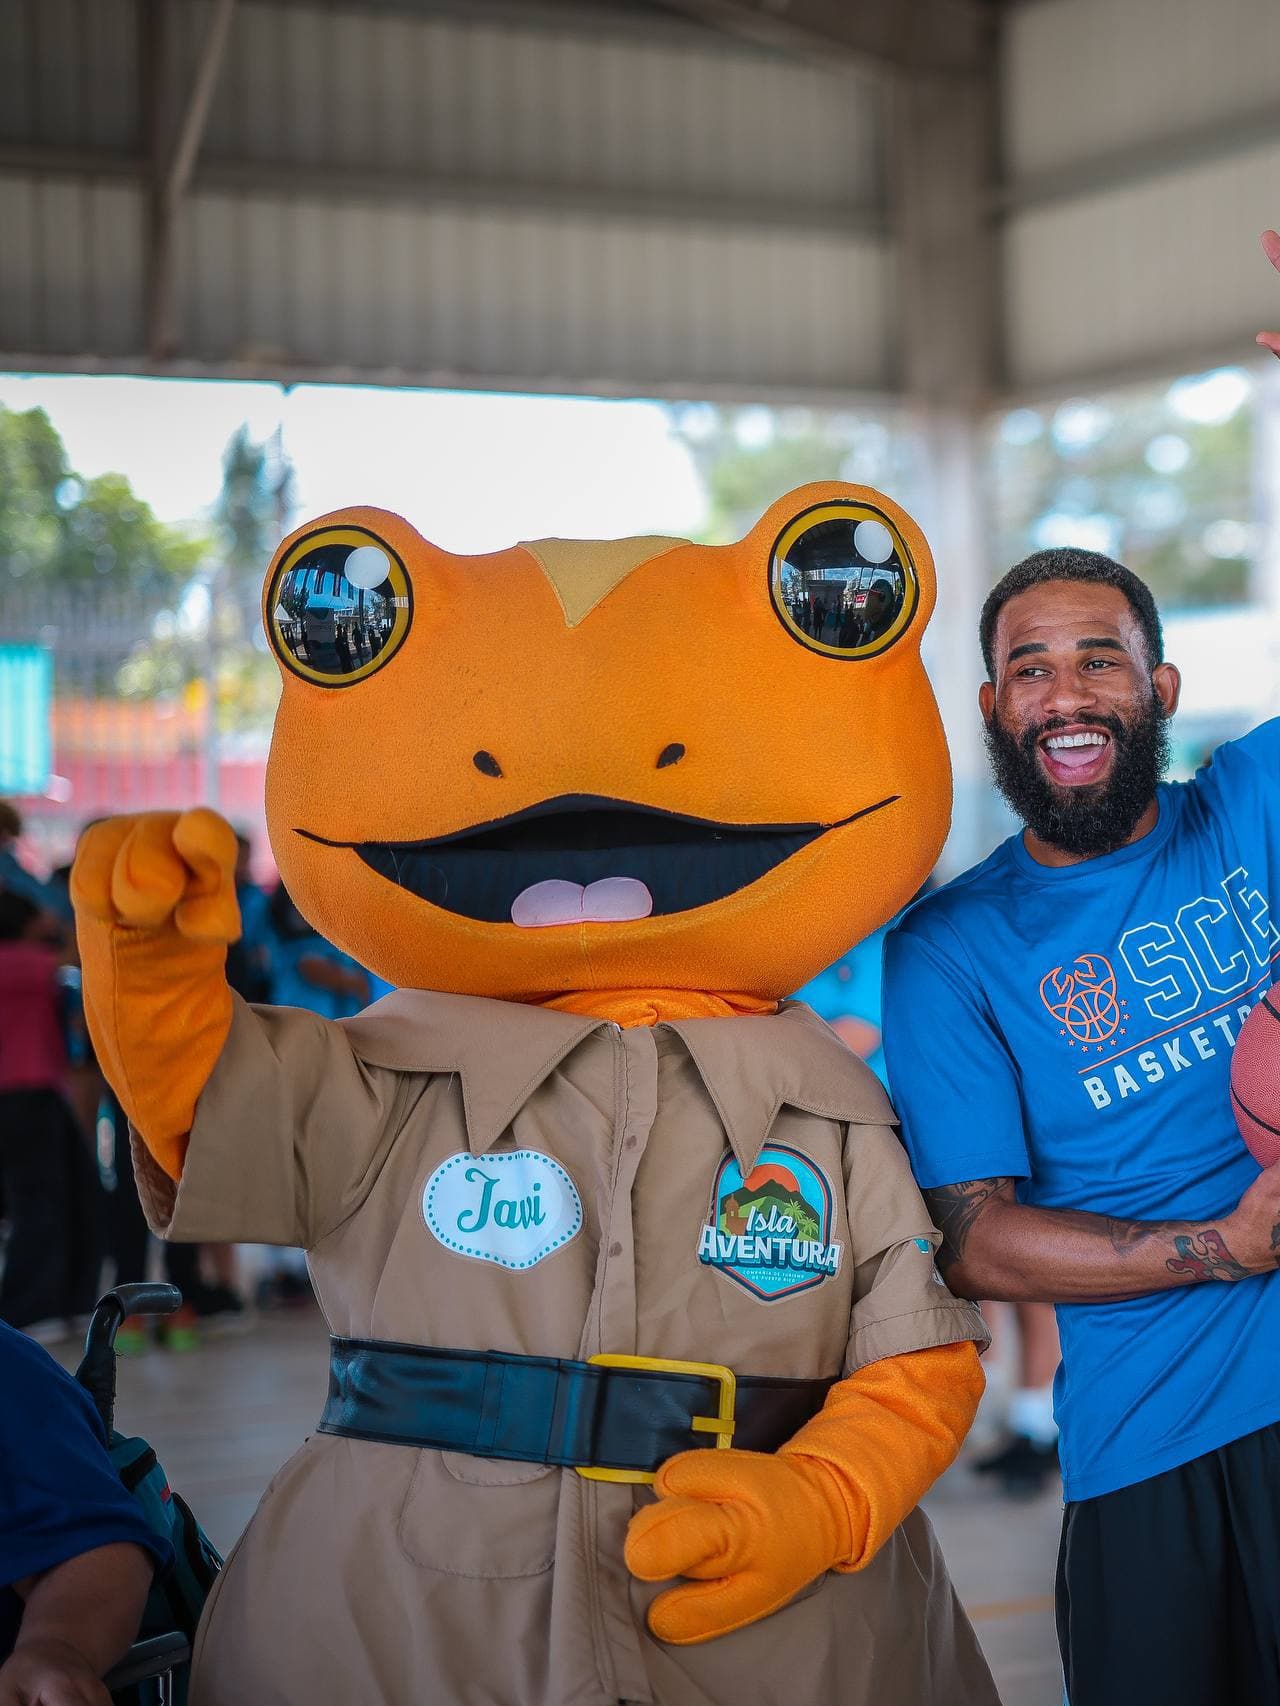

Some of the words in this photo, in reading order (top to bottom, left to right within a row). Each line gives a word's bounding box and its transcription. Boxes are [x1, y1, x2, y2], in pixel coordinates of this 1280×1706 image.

[457, 1167, 546, 1233] Javi
[746, 1204, 797, 1235] Isla
[698, 1224, 841, 1268] AVENTURA
